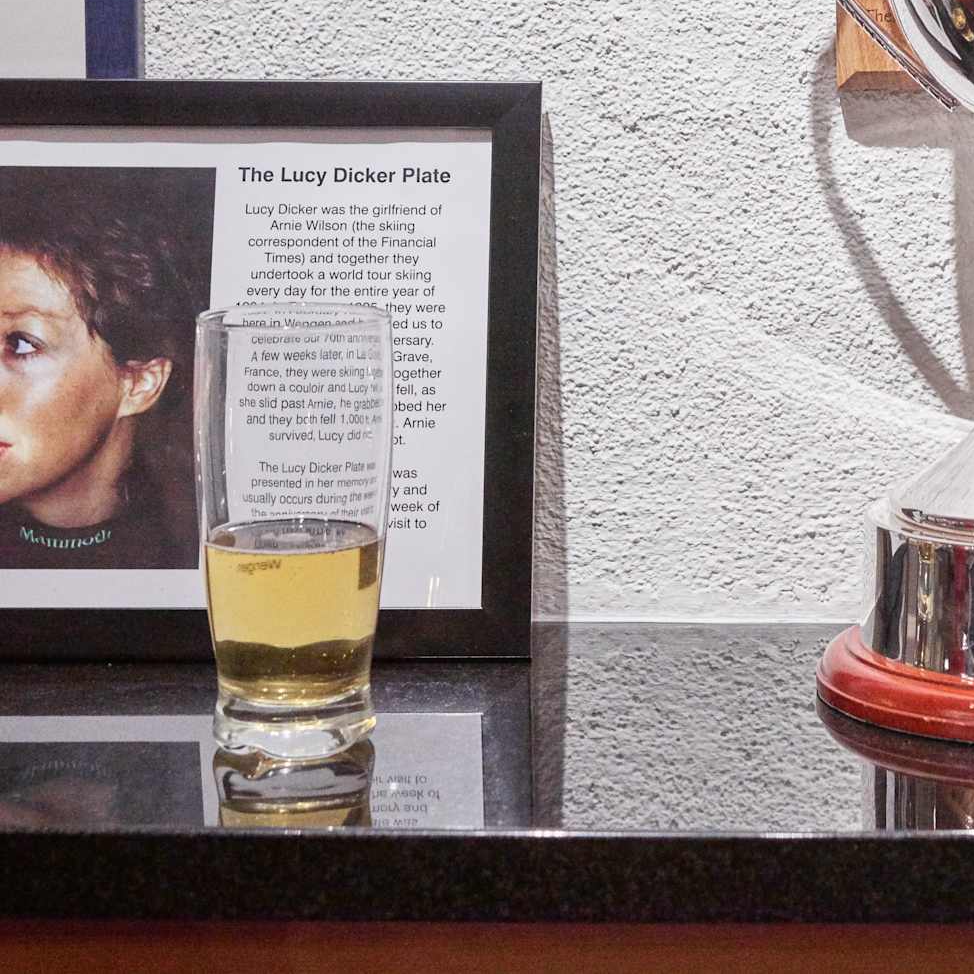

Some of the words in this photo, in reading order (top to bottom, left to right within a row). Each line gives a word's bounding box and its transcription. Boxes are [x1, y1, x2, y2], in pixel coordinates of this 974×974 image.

[239, 167, 274, 182] The
[281, 167, 326, 186] Lucy
[334, 168, 396, 183] Dicker
[402, 168, 451, 183] Plate
[245, 205, 274, 217] Lucy
[278, 204, 317, 215] Dicker
[321, 206, 345, 215] was
[350, 205, 368, 215] the
[373, 204, 425, 217] girlfriend
[431, 204, 442, 215] of
[270, 221, 301, 231] Arnie
[307, 221, 347, 231] Wilson
[352, 221, 375, 233] (the
[379, 221, 415, 234] skiing
[248, 237, 338, 250] correspondent
[343, 237, 354, 248] of
[358, 237, 376, 248] the
[382, 237, 436, 248] Financial
[265, 253, 304, 265] Times)
[310, 253, 333, 264] and
[338, 254, 388, 267] together
[393, 253, 419, 266] they
[251, 269, 313, 280] undertook
[318, 272, 325, 280] a
[330, 269, 362, 280] world
[367, 271, 390, 280] tour
[396, 270, 431, 283] skiing
[247, 288, 280, 299] every
[284, 286, 306, 299] day
[311, 286, 326, 296] for
[331, 286, 350, 297] the
[355, 286, 388, 297] entire
[393, 288, 418, 300] year
[424, 285, 435, 297] of
[385, 302, 410, 316] they
[415, 304, 445, 313] were
[412, 320, 426, 330] us
[431, 319, 442, 330] to
[251, 351, 258, 362] A
[262, 350, 280, 361] few
[284, 350, 317, 361] weeks
[320, 350, 343, 361] later,
[347, 349, 354, 360] in
[244, 367, 281, 378] France,
[285, 367, 308, 379] they
[311, 368, 336, 377] were
[339, 367, 364, 379] skiing
[248, 383, 275, 392] down
[279, 384, 285, 393] a
[289, 383, 324, 393] couloir
[328, 382, 345, 393] and
[349, 383, 367, 394] Lucy
[396, 385, 417, 396] fell,
[422, 386, 435, 395] as
[426, 401, 446, 412] her
[403, 417, 435, 428] Arnie
[269, 431, 315, 442] survived,
[319, 431, 343, 443] Lucy
[347, 430, 360, 440] did
[259, 462, 278, 473] The
[282, 462, 306, 476] Lucy
[310, 462, 342, 474] Dicker
[393, 468, 418, 478] was
[251, 478, 301, 489] presented
[305, 478, 313, 488] in
[317, 478, 333, 488] her
[404, 484, 427, 495] and
[390, 501, 423, 512] week
[428, 501, 440, 512] of
[415, 518, 426, 529] to
